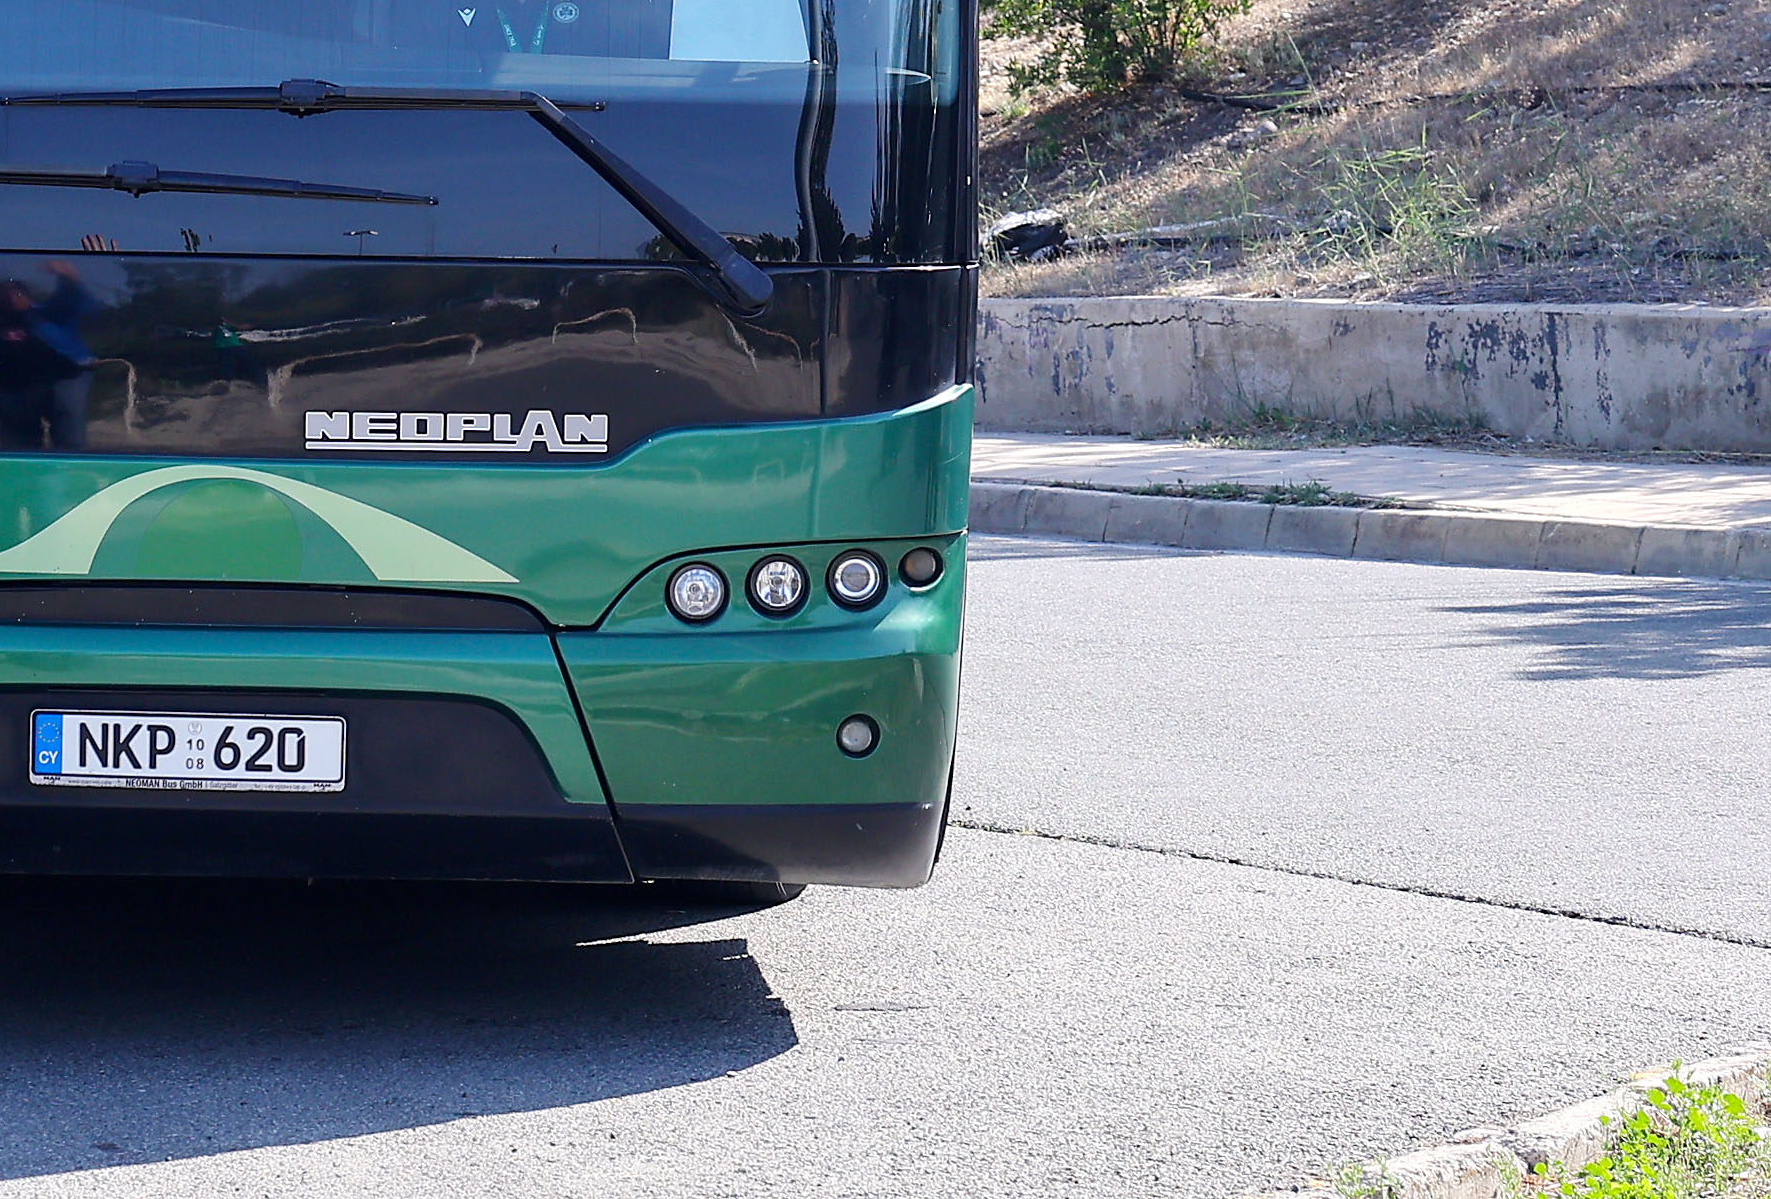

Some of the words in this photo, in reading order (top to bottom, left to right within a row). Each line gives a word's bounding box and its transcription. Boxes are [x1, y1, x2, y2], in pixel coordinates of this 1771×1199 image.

[305, 409, 609, 452] NEOPLAN
[78, 722, 177, 770] NKP
[213, 725, 306, 773] 620
[186, 738, 205, 752] 10
[38, 750, 59, 765] CY
[186, 757, 205, 770] 08
[125, 779, 160, 788] NEOMAN
[162, 779, 177, 788] Bus
[179, 780, 203, 789] GmbH
